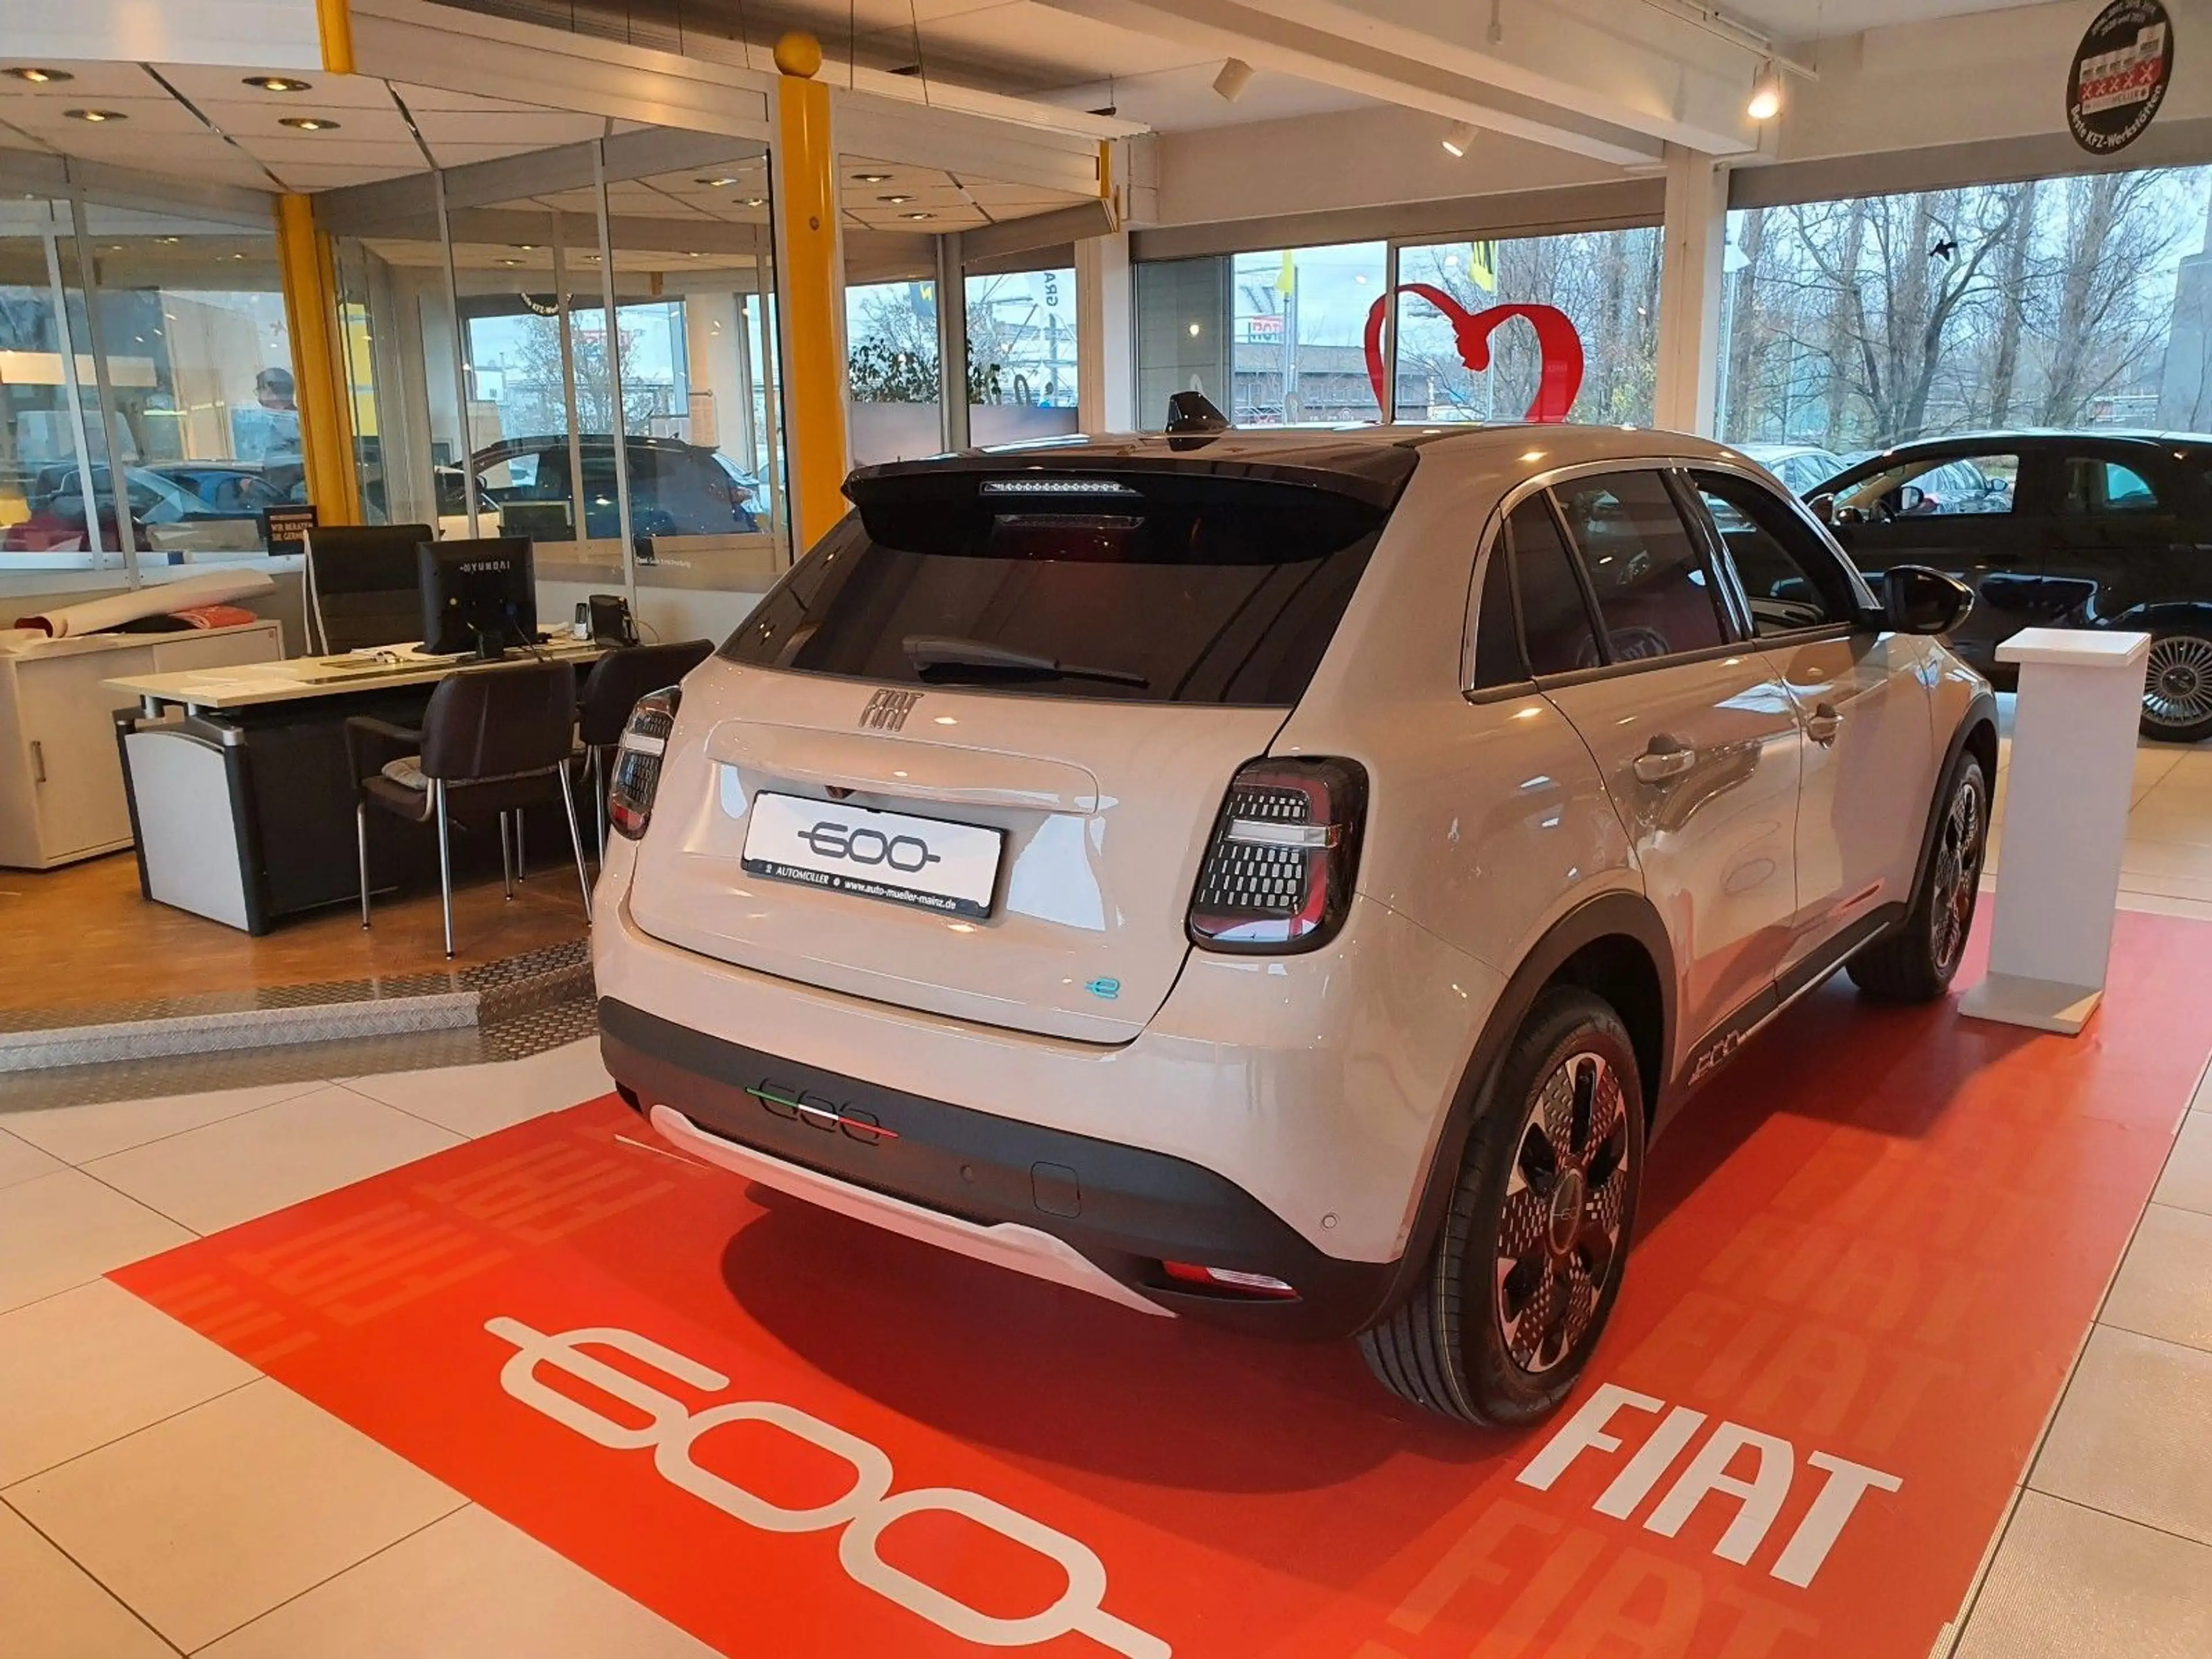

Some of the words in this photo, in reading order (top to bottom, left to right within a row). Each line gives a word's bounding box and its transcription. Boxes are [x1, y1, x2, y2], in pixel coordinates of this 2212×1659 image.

[461, 560, 510, 573] HYUNDAI
[858, 688, 925, 732] FIAT
[798, 821, 941, 872] 600
[844, 880, 956, 910] www.auto-mueller-mainz.de
[483, 1316, 1172, 1659] 600
[1515, 1382, 1904, 1590] FIAT
